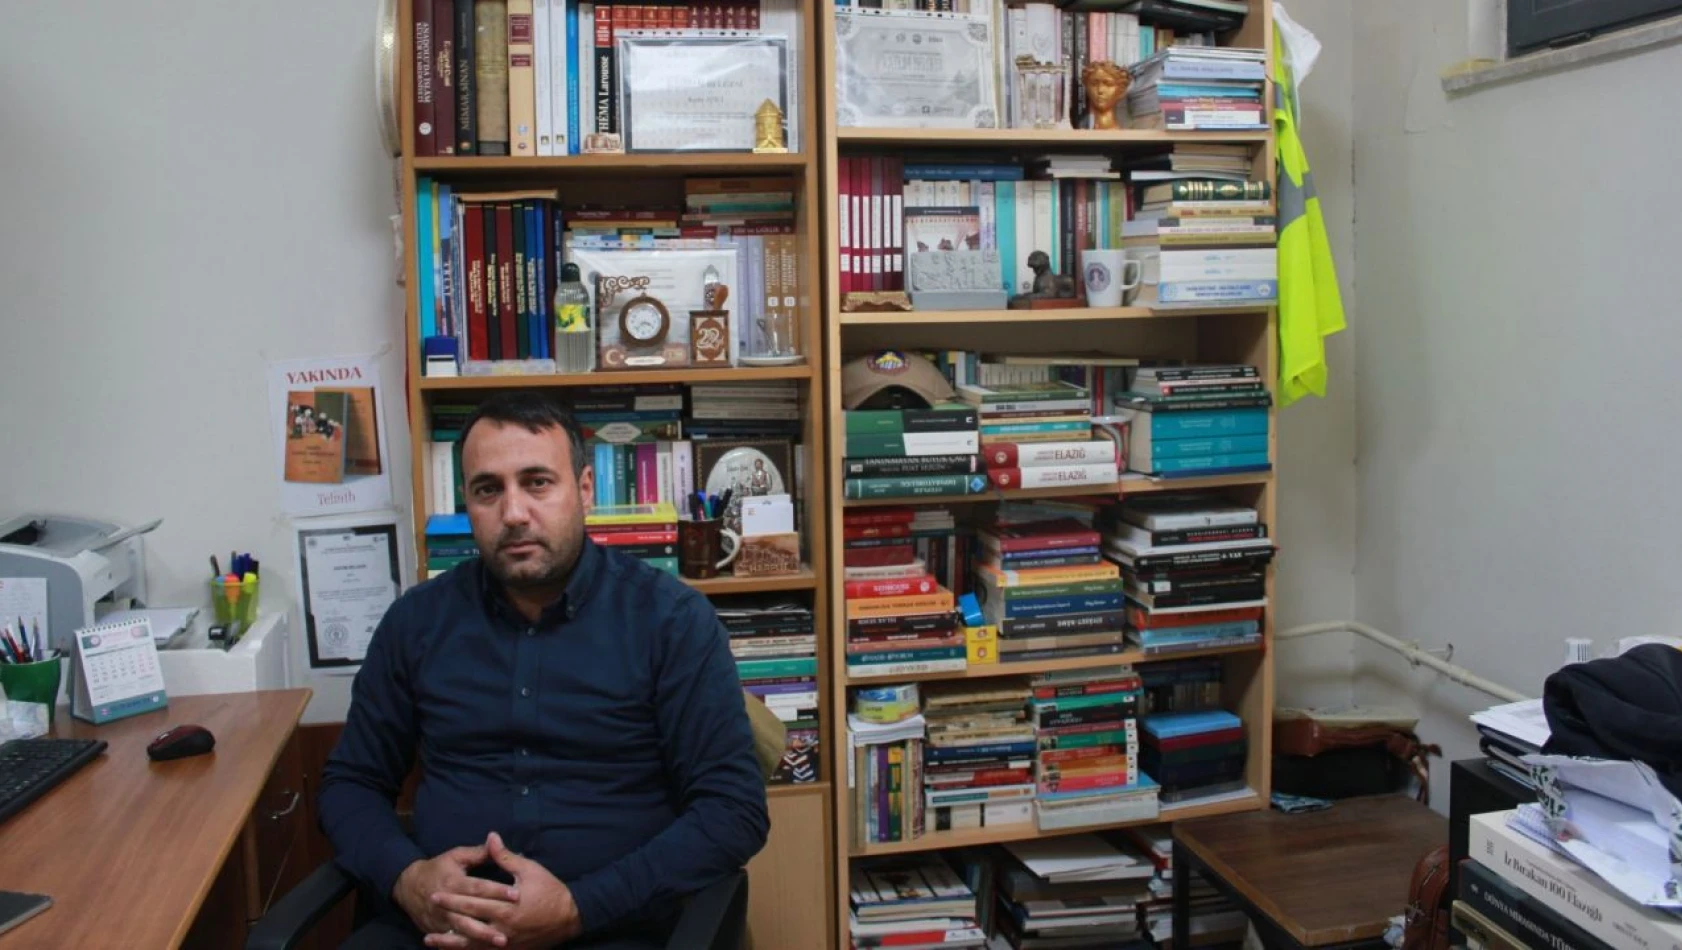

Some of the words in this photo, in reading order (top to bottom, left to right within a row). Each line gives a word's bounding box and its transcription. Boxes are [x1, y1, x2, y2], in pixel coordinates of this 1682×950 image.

[598, 56, 609, 96] Larousse
[286, 366, 363, 385] YAKINDA
[1055, 447, 1086, 460] ELAZIĞ
[1058, 468, 1087, 481] ELAZIĞ
[1513, 857, 1548, 889] Bırakan
[1550, 880, 1566, 900] 100
